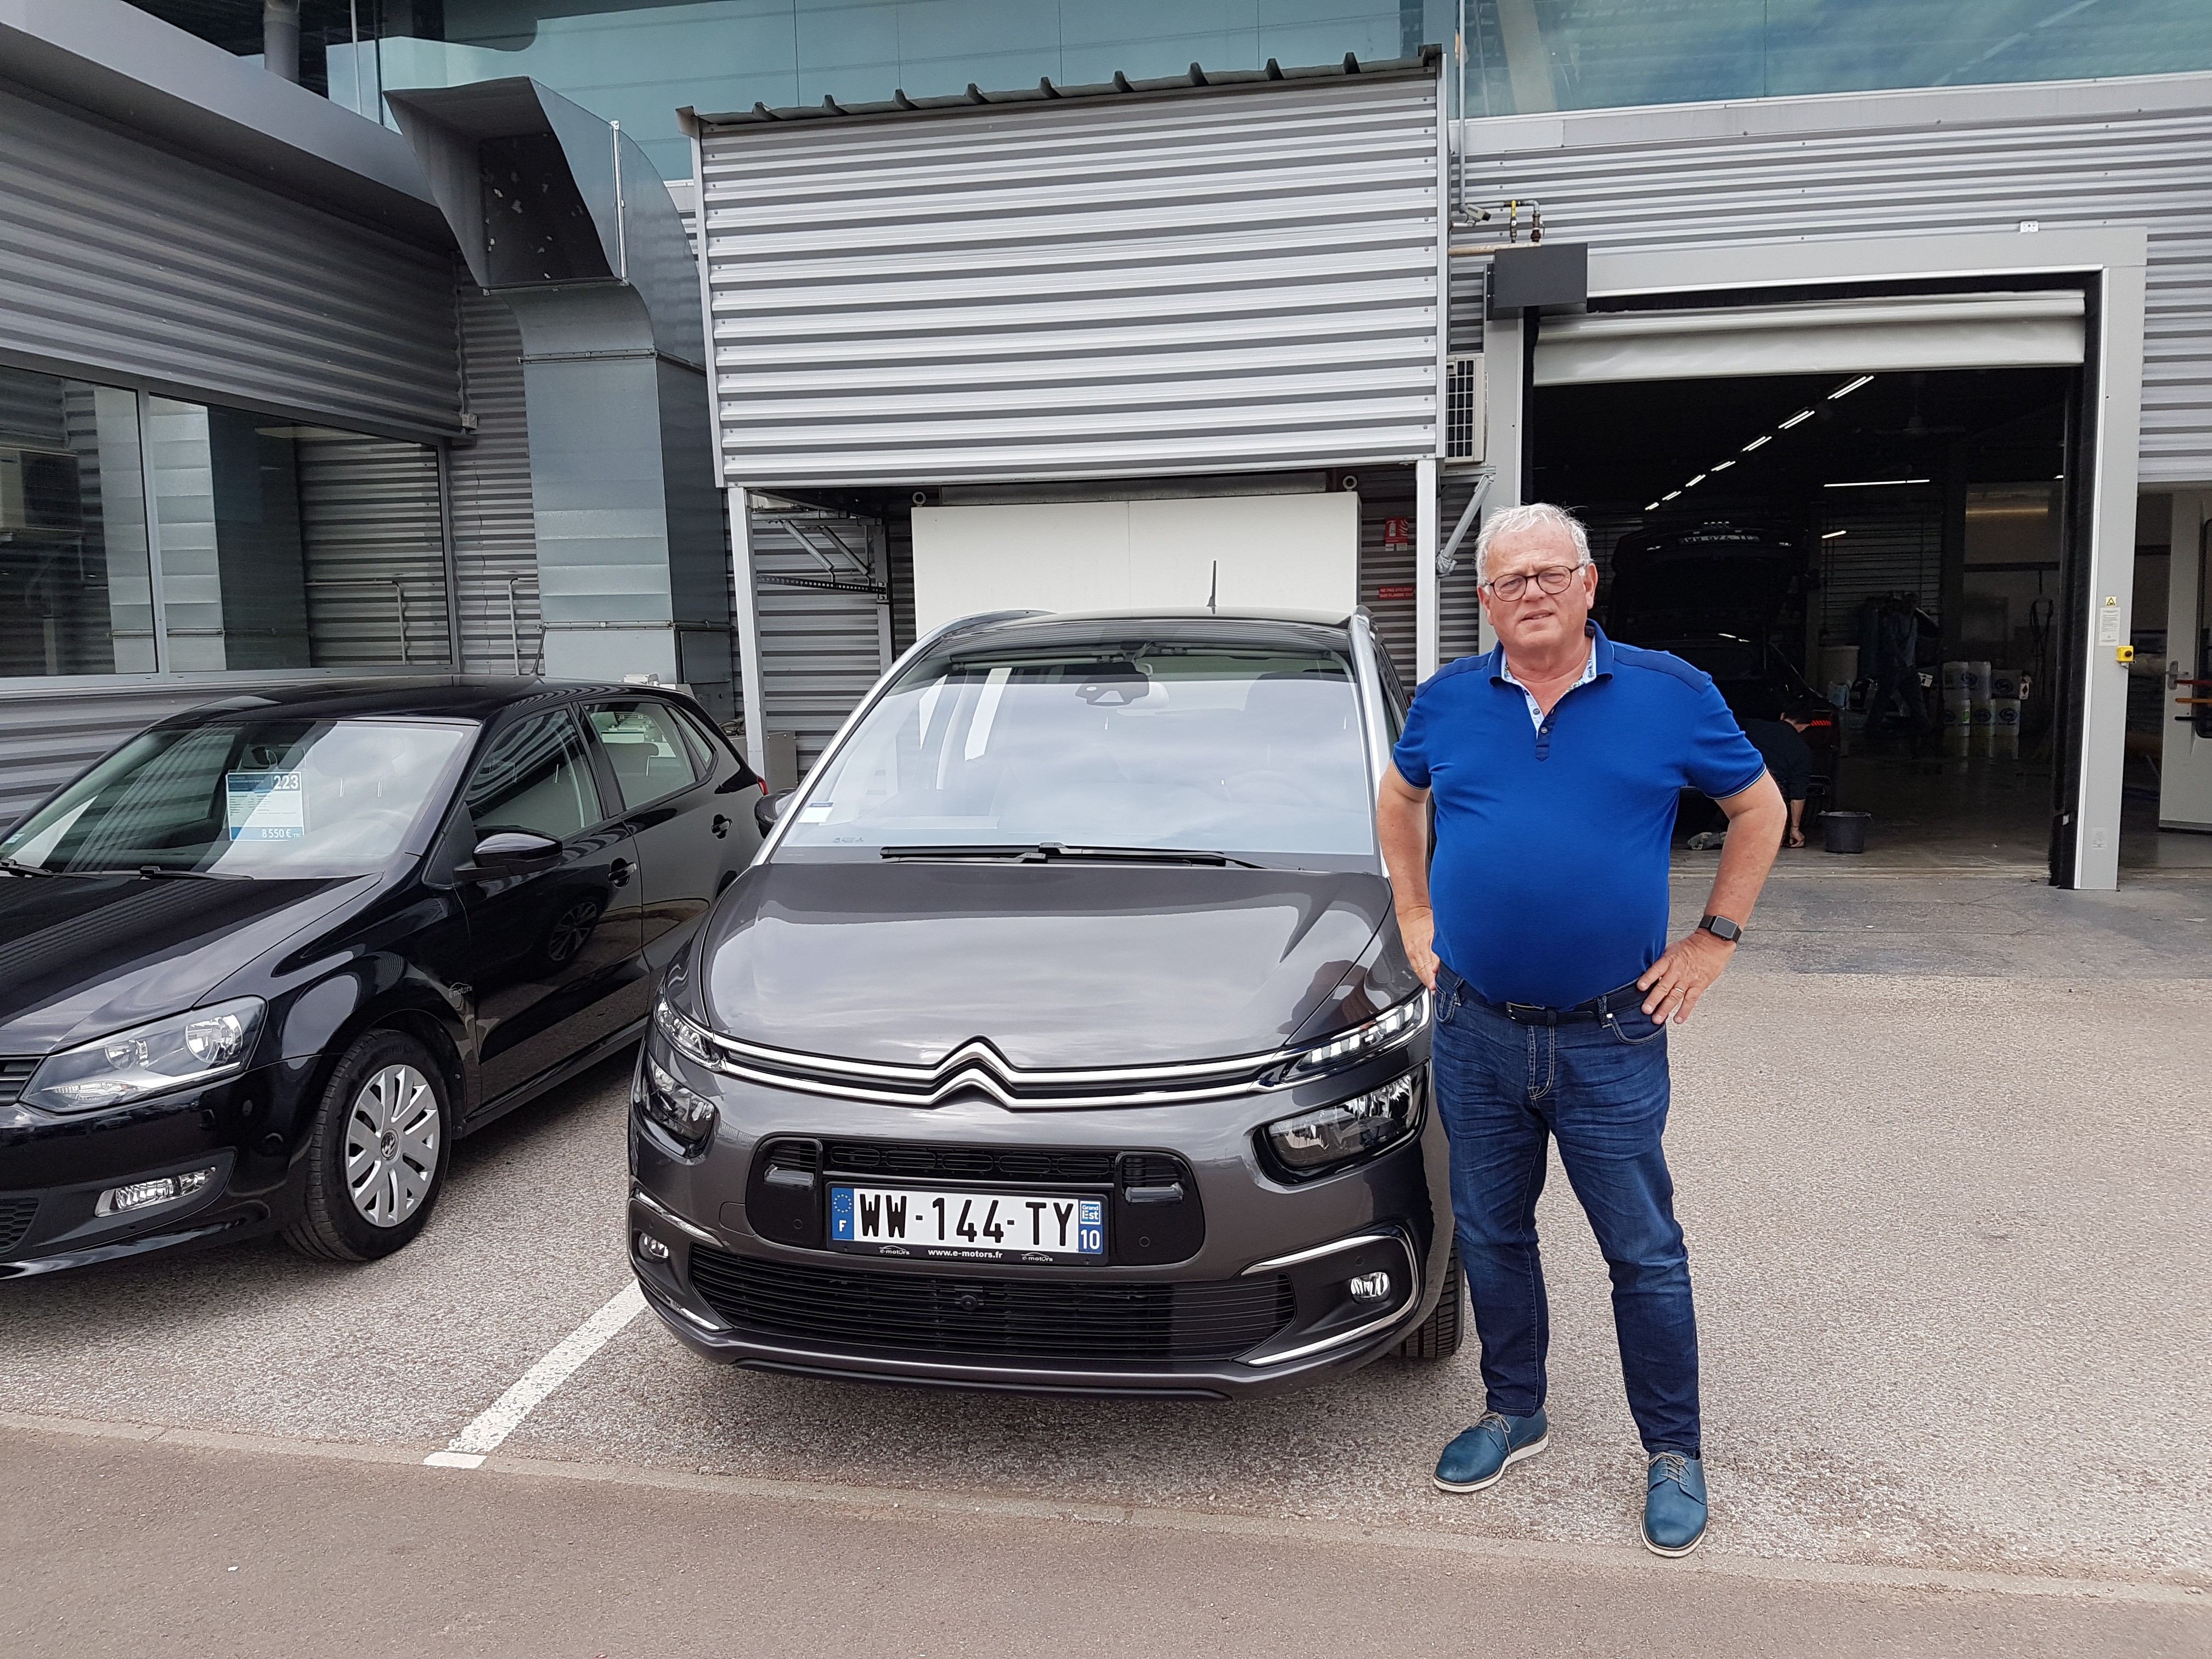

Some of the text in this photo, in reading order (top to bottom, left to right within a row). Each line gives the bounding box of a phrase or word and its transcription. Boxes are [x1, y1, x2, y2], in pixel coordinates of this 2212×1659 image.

[274, 775, 298, 789] 223
[1082, 1210, 1099, 1220] Est
[839, 1220, 847, 1232] F
[1080, 1229, 1100, 1250] 10
[928, 1249, 1003, 1259] www.e-motors.fr
